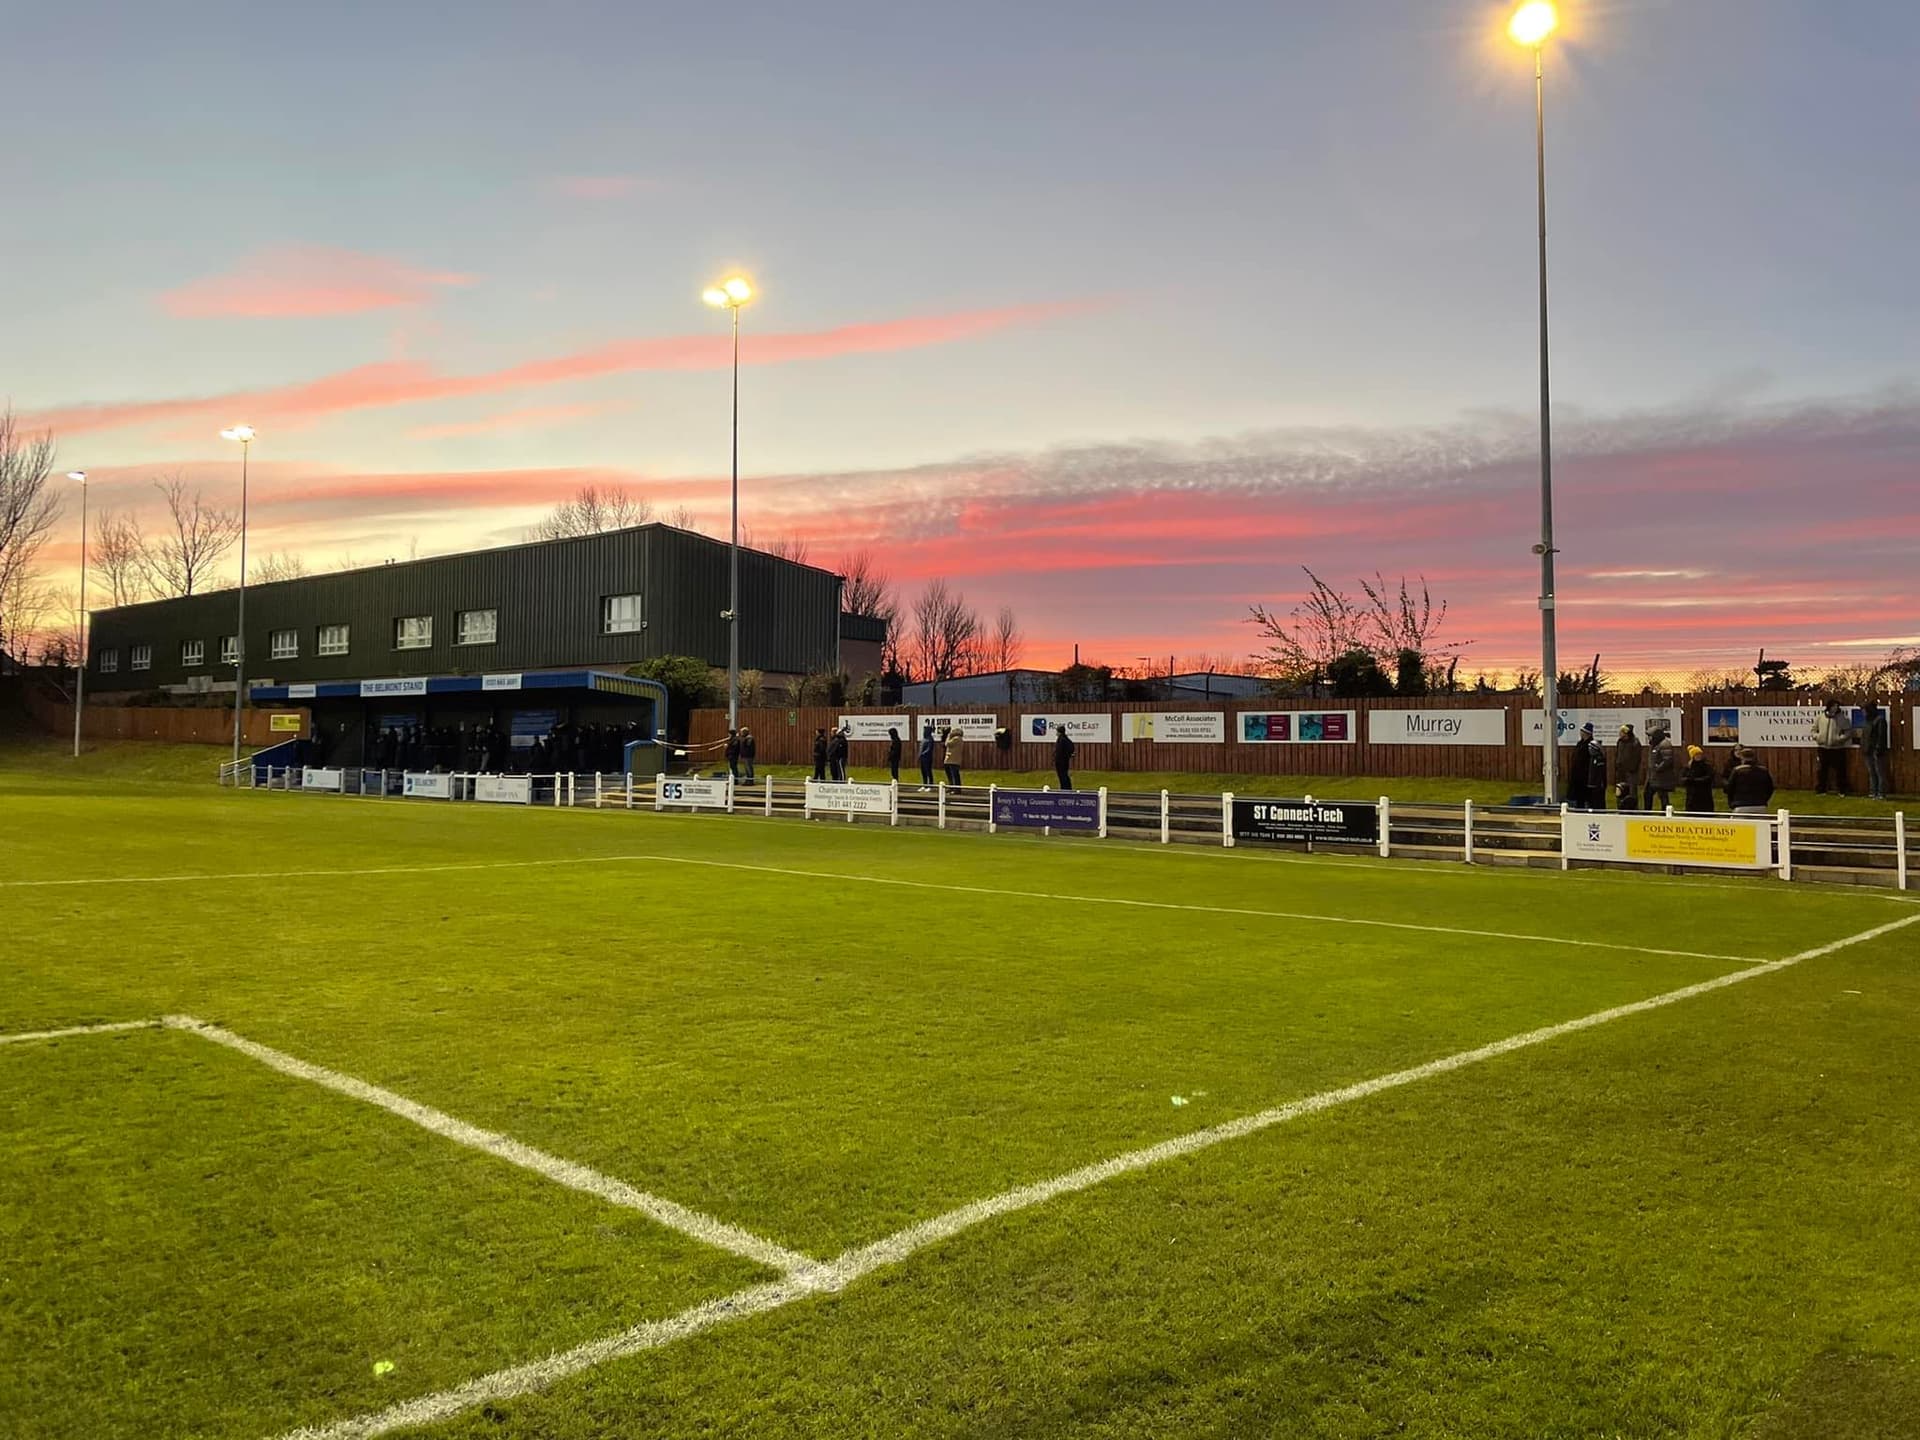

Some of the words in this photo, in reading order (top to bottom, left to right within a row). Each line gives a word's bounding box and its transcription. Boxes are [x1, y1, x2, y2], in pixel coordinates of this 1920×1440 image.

[402, 681, 424, 691] STAND
[1406, 714, 1462, 736] Murray
[663, 783, 682, 799] EFS
[1253, 805, 1268, 820] ST
[1269, 805, 1344, 823] Connect-Tech
[1643, 824, 1673, 833] COLIN
[1675, 825, 1712, 835] BEATTIE
[1716, 827, 1736, 837] MSP
